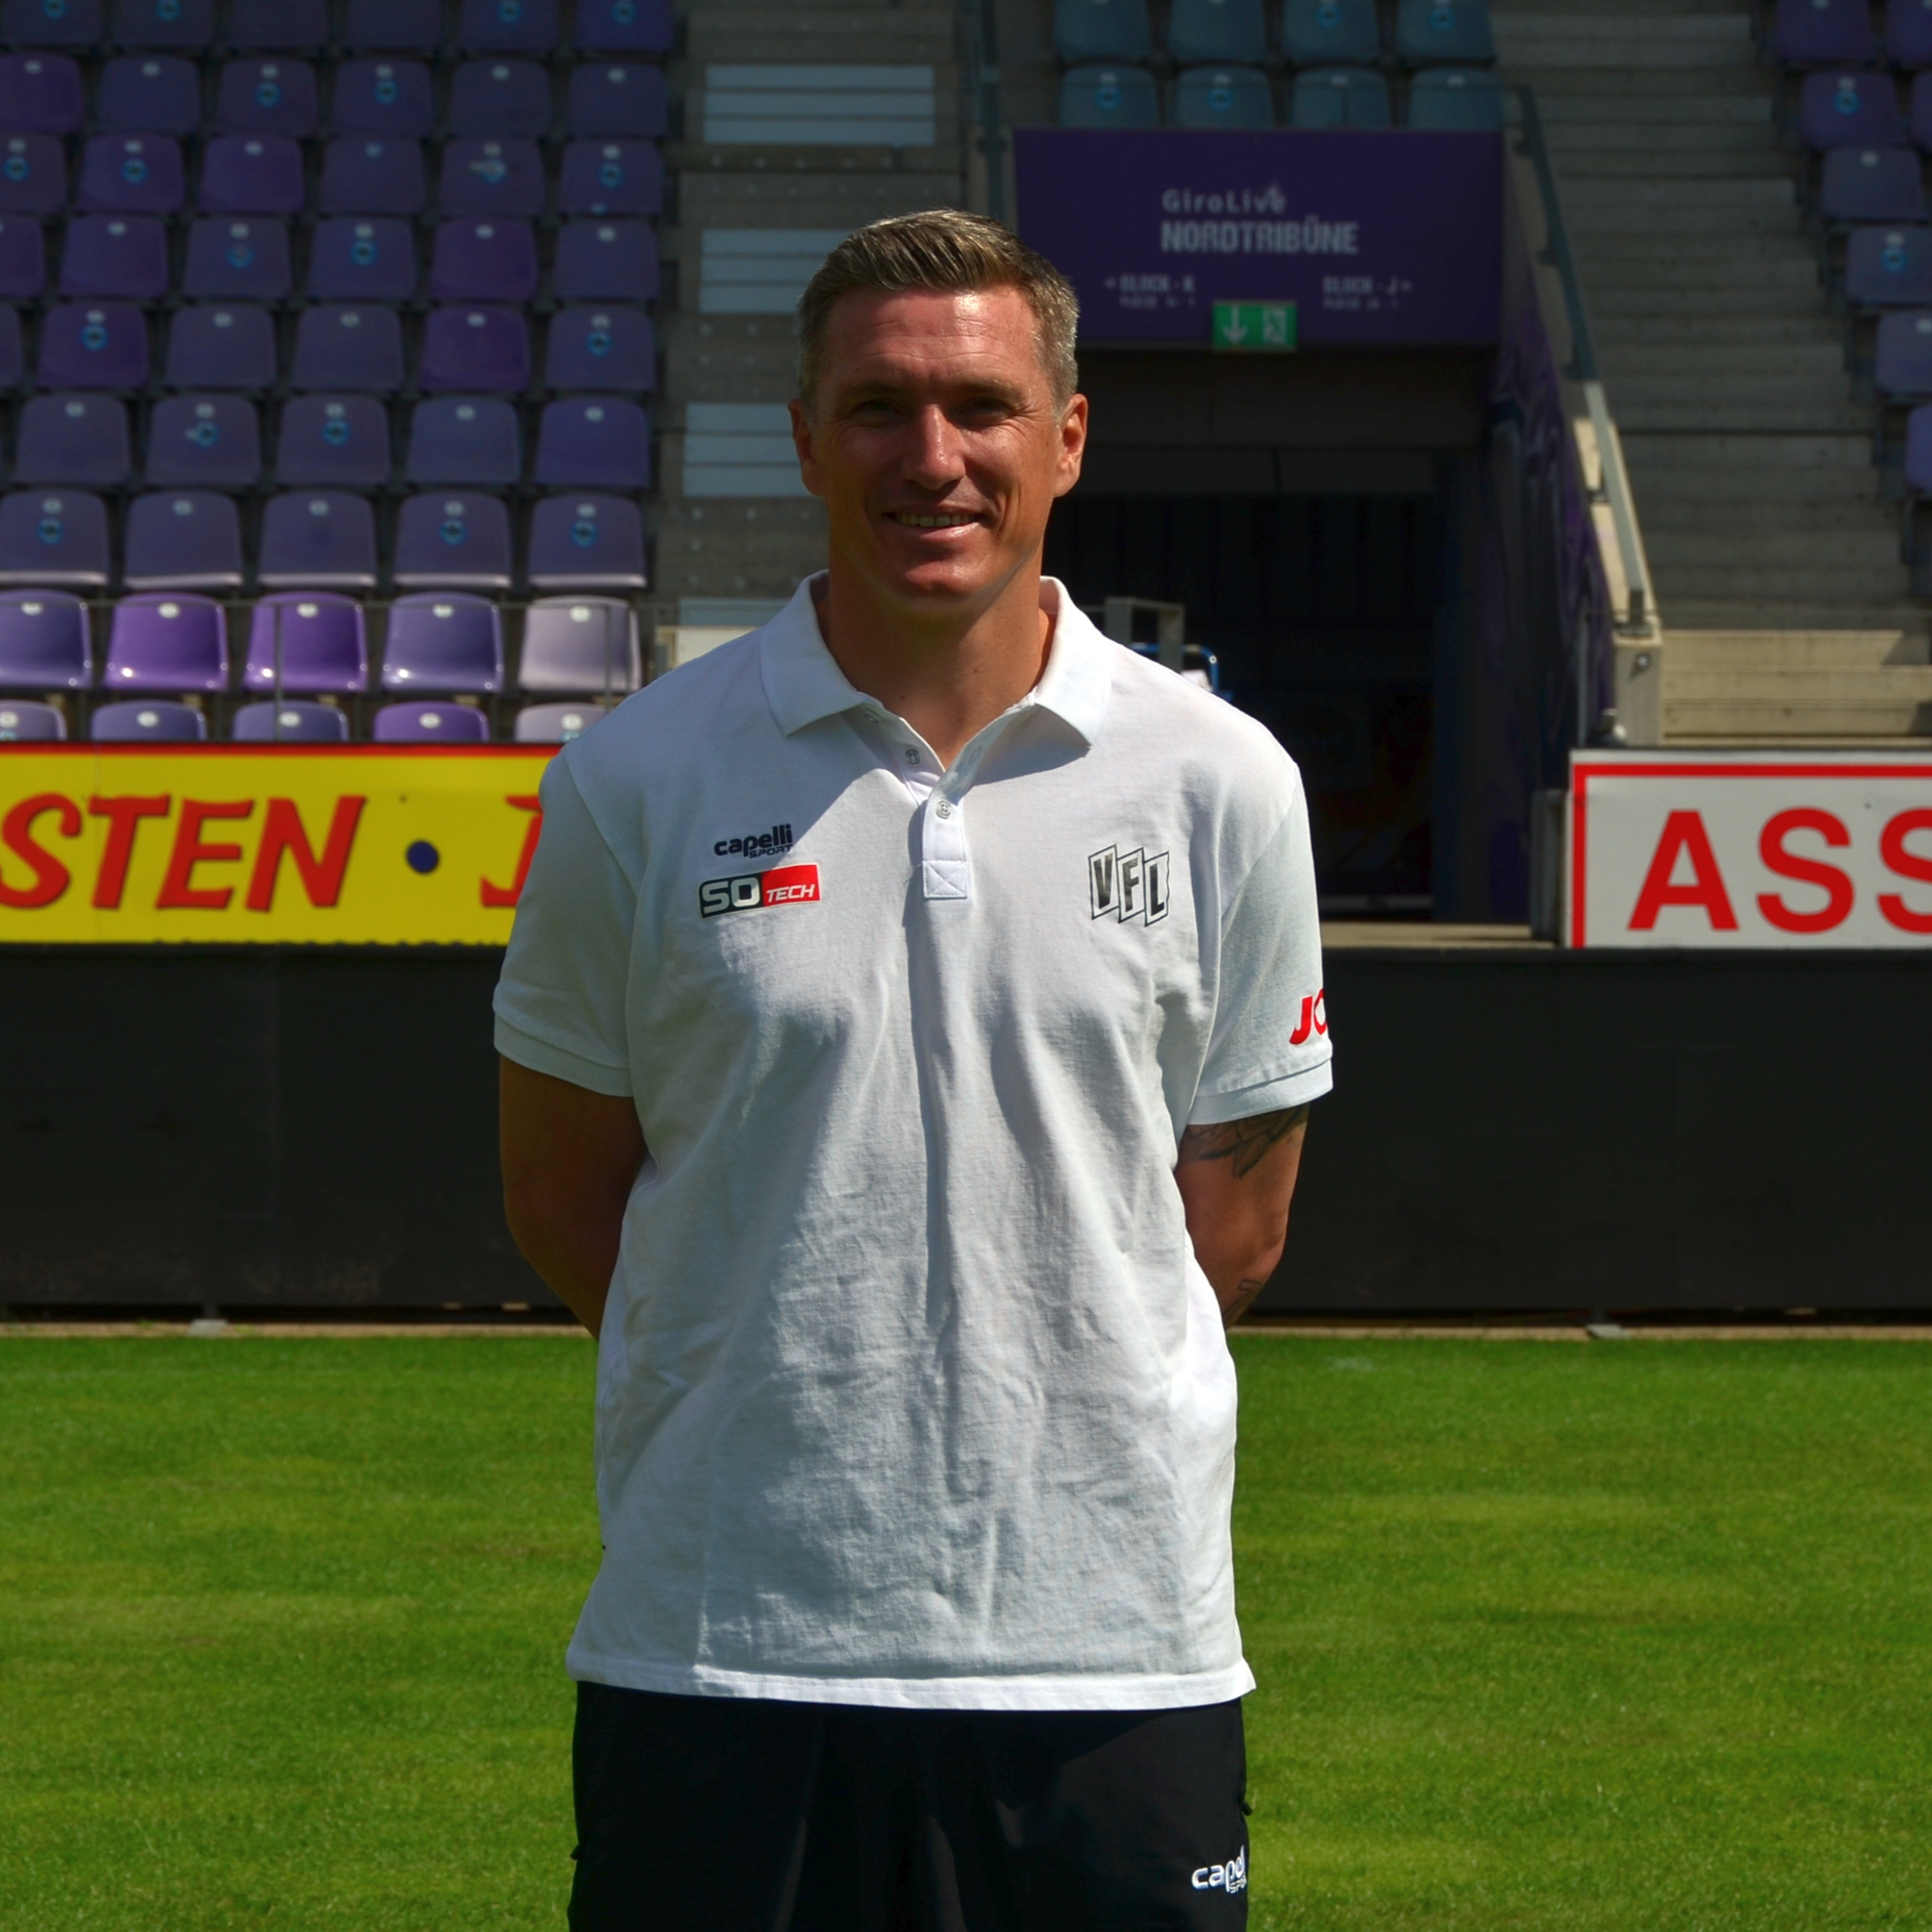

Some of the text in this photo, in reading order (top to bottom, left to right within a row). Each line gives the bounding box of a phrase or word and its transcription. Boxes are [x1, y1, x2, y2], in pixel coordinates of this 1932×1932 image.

[1162, 187, 1285, 213] GiroLive
[1160, 215, 1358, 254] NORDTRIBÜNE
[1119, 274, 1170, 292] BLOCK
[1323, 276, 1373, 295] BLOCK
[714, 824, 793, 857] capelli
[749, 844, 793, 858] SPORT
[1627, 806, 1932, 934] ASS
[701, 876, 816, 914] SO TECH
